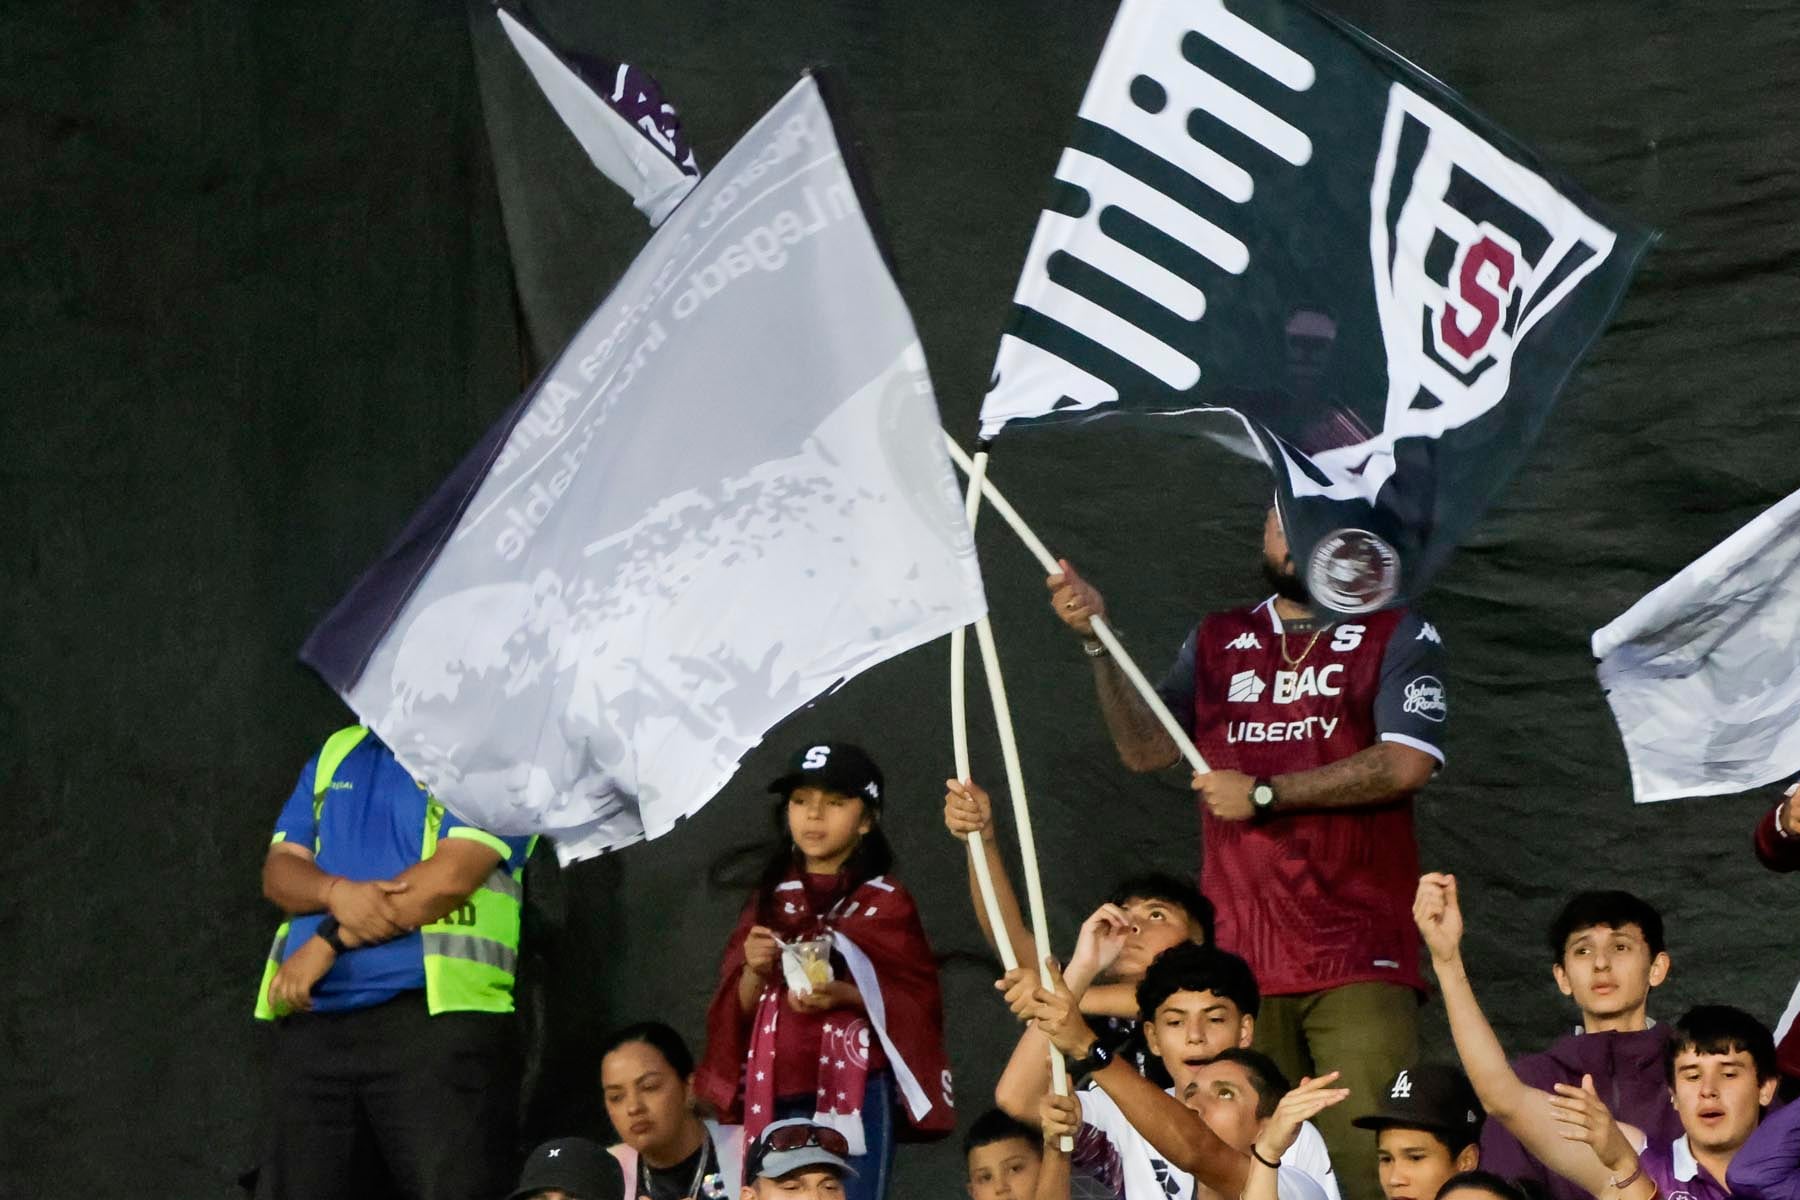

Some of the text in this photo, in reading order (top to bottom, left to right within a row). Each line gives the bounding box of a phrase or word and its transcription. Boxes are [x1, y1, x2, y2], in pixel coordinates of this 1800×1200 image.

[1330, 624, 1366, 652] S
[1272, 664, 1345, 704] BAC
[1227, 716, 1339, 743] LIBERTY
[802, 746, 830, 770] S
[1390, 1070, 1413, 1098] LA
